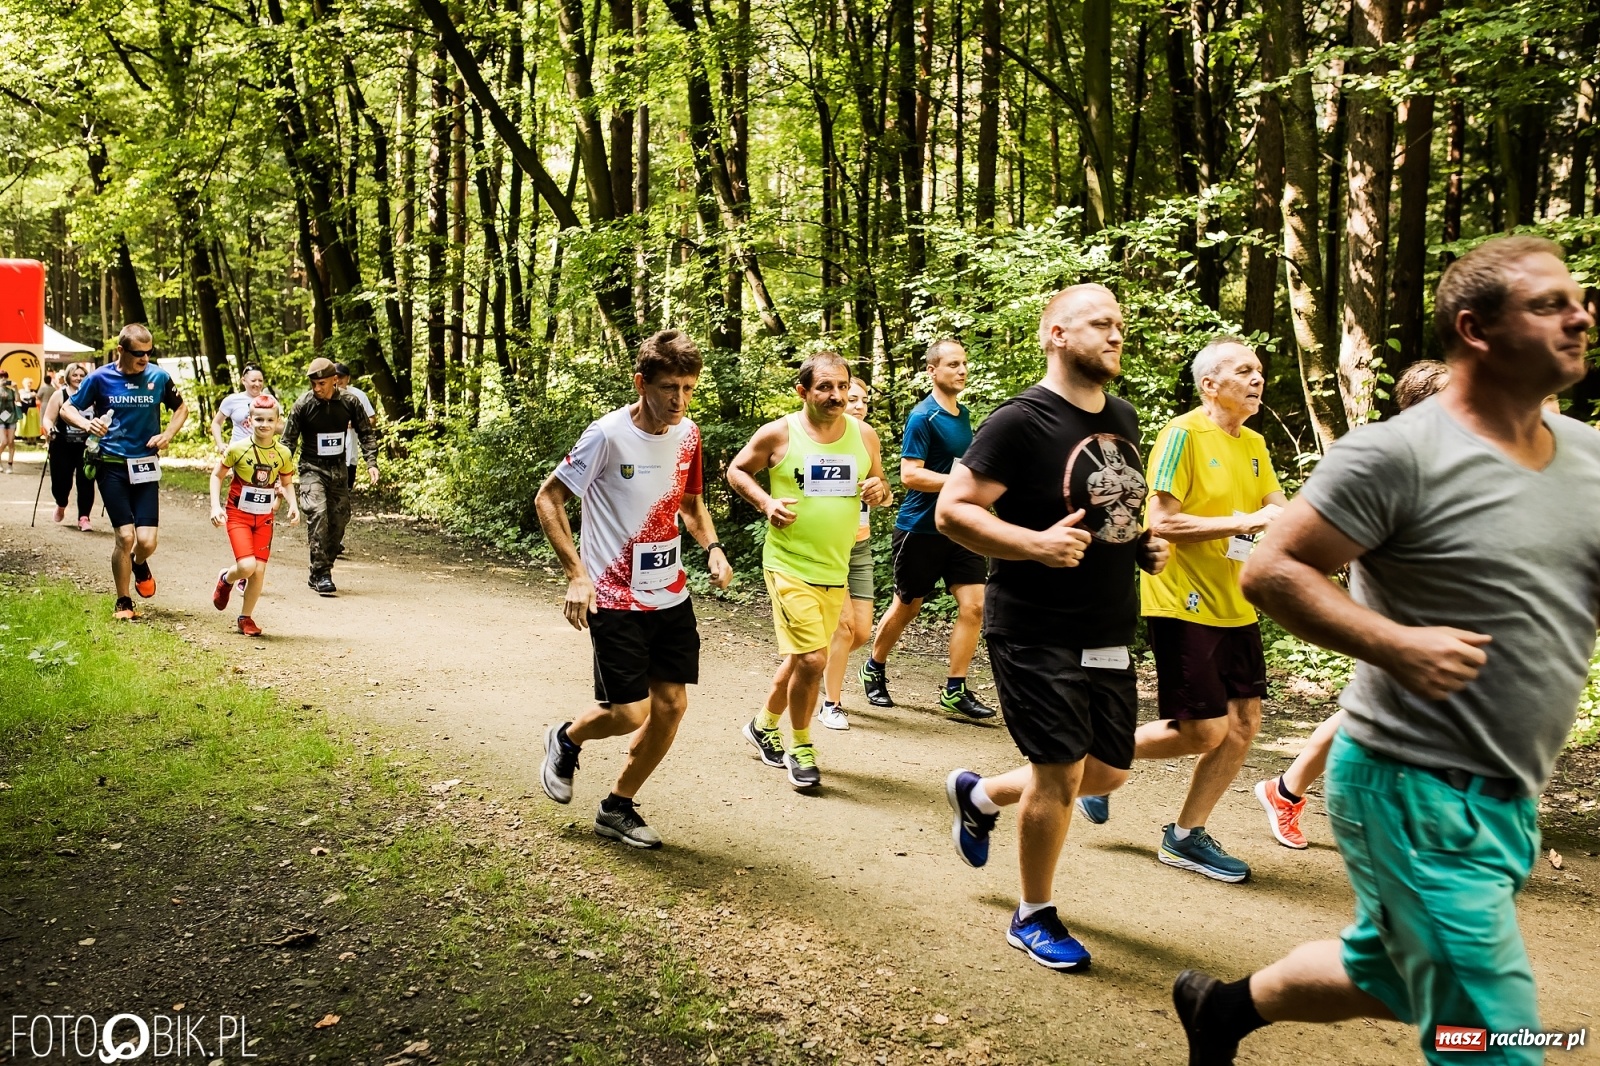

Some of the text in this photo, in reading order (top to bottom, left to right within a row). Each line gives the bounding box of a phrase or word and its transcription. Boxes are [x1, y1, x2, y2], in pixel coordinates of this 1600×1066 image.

[108, 395, 154, 404] RUNNERS
[138, 463, 150, 472] 54
[822, 466, 841, 478] 72
[253, 494, 266, 503] 55
[653, 551, 670, 567] 31
